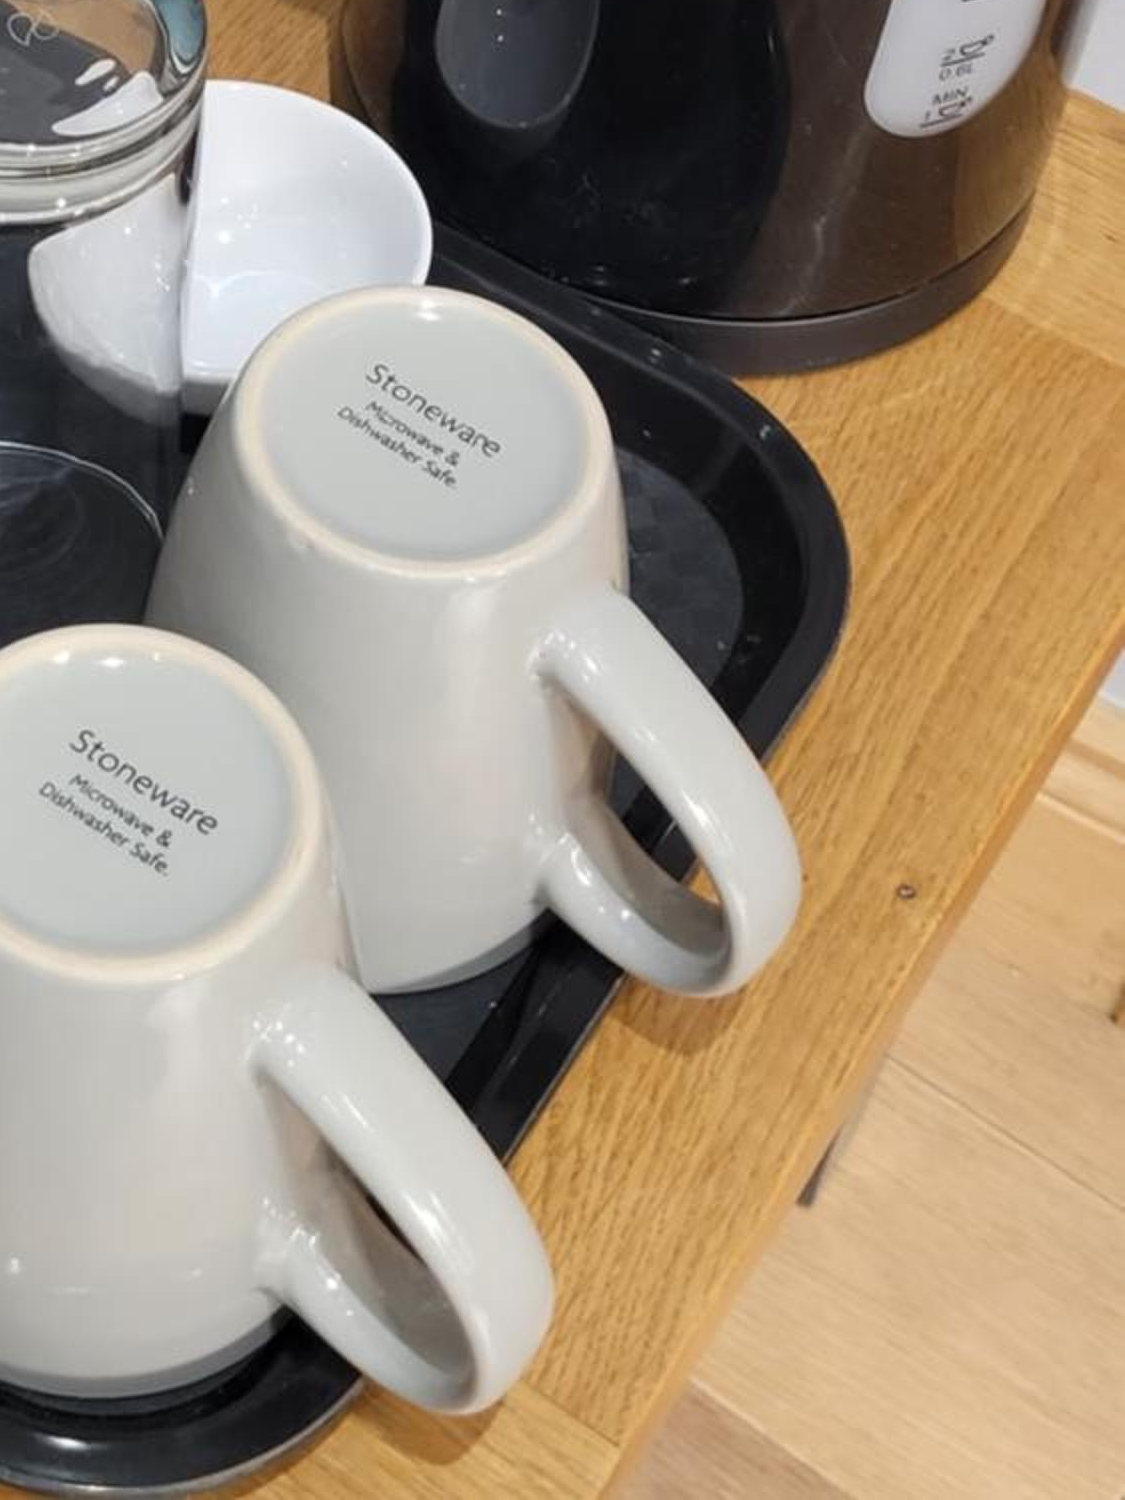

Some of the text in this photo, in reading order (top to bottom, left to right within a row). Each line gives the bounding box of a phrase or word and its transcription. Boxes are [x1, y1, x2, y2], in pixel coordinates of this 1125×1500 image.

[337, 406, 423, 465] Dishwasher
[365, 363, 502, 458] Stoneware
[365, 401, 461, 467] Microwave &
[69, 728, 219, 836] Stoneware
[69, 773, 173, 849] Microwave &
[38, 781, 169, 878] Dishwasher Safe.
